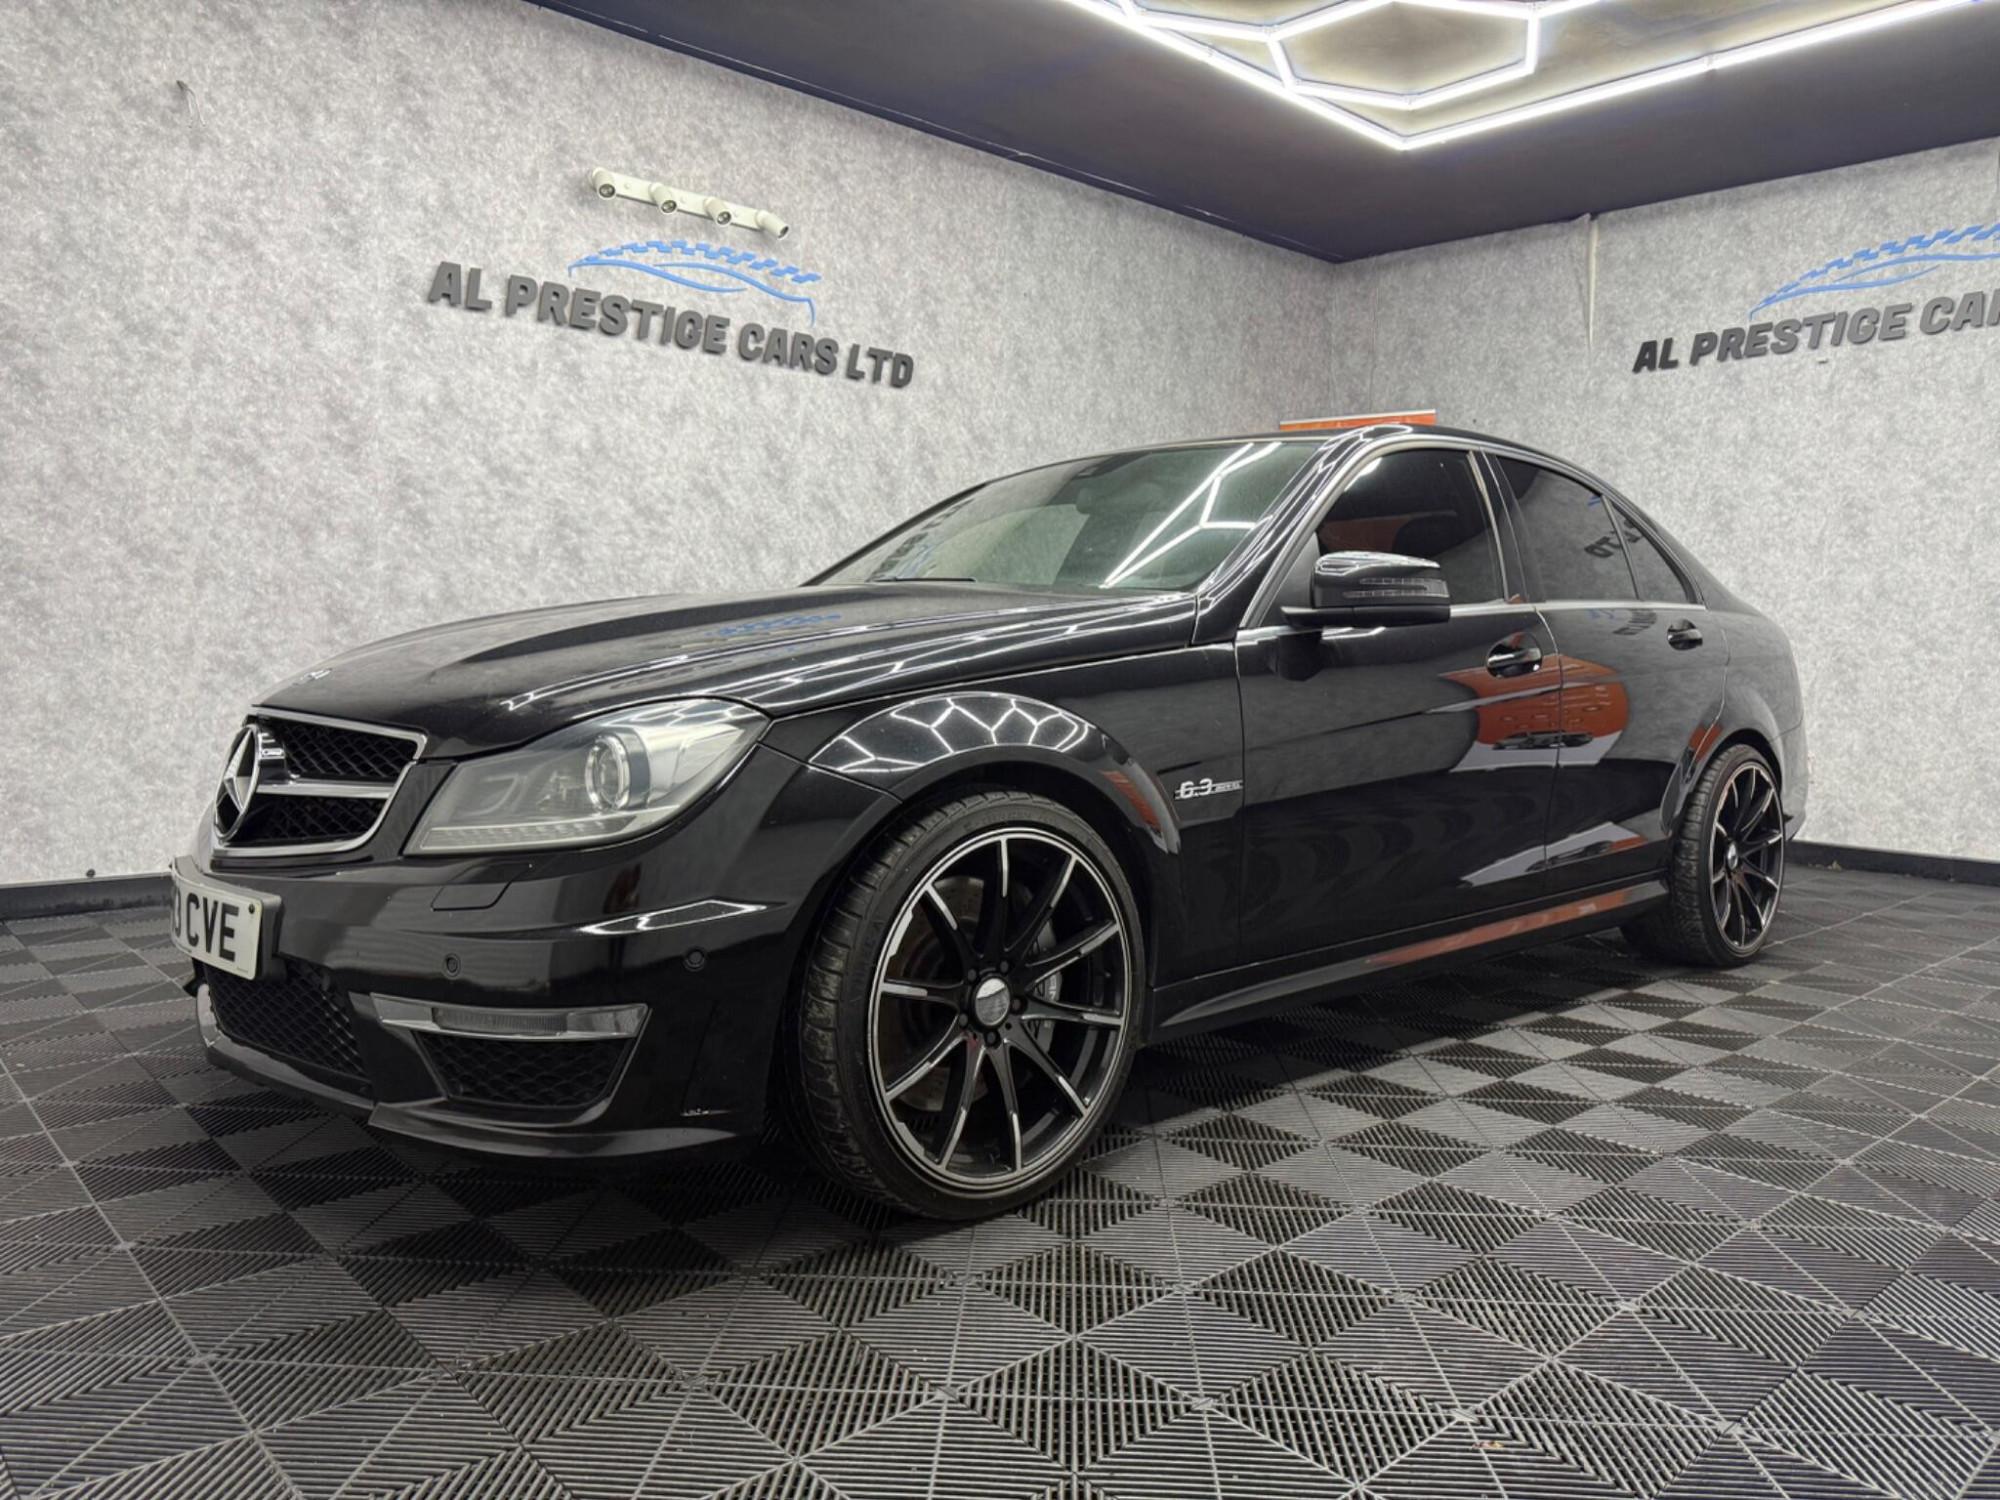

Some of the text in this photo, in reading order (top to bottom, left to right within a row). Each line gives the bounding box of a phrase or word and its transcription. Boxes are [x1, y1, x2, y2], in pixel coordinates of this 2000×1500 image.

[427, 260, 915, 389] AL PRESTIGE CARS LTD
[1632, 337, 1679, 373] AL
[1689, 302, 1912, 366] PRESTIGE
[1180, 777, 1213, 799] 6.3
